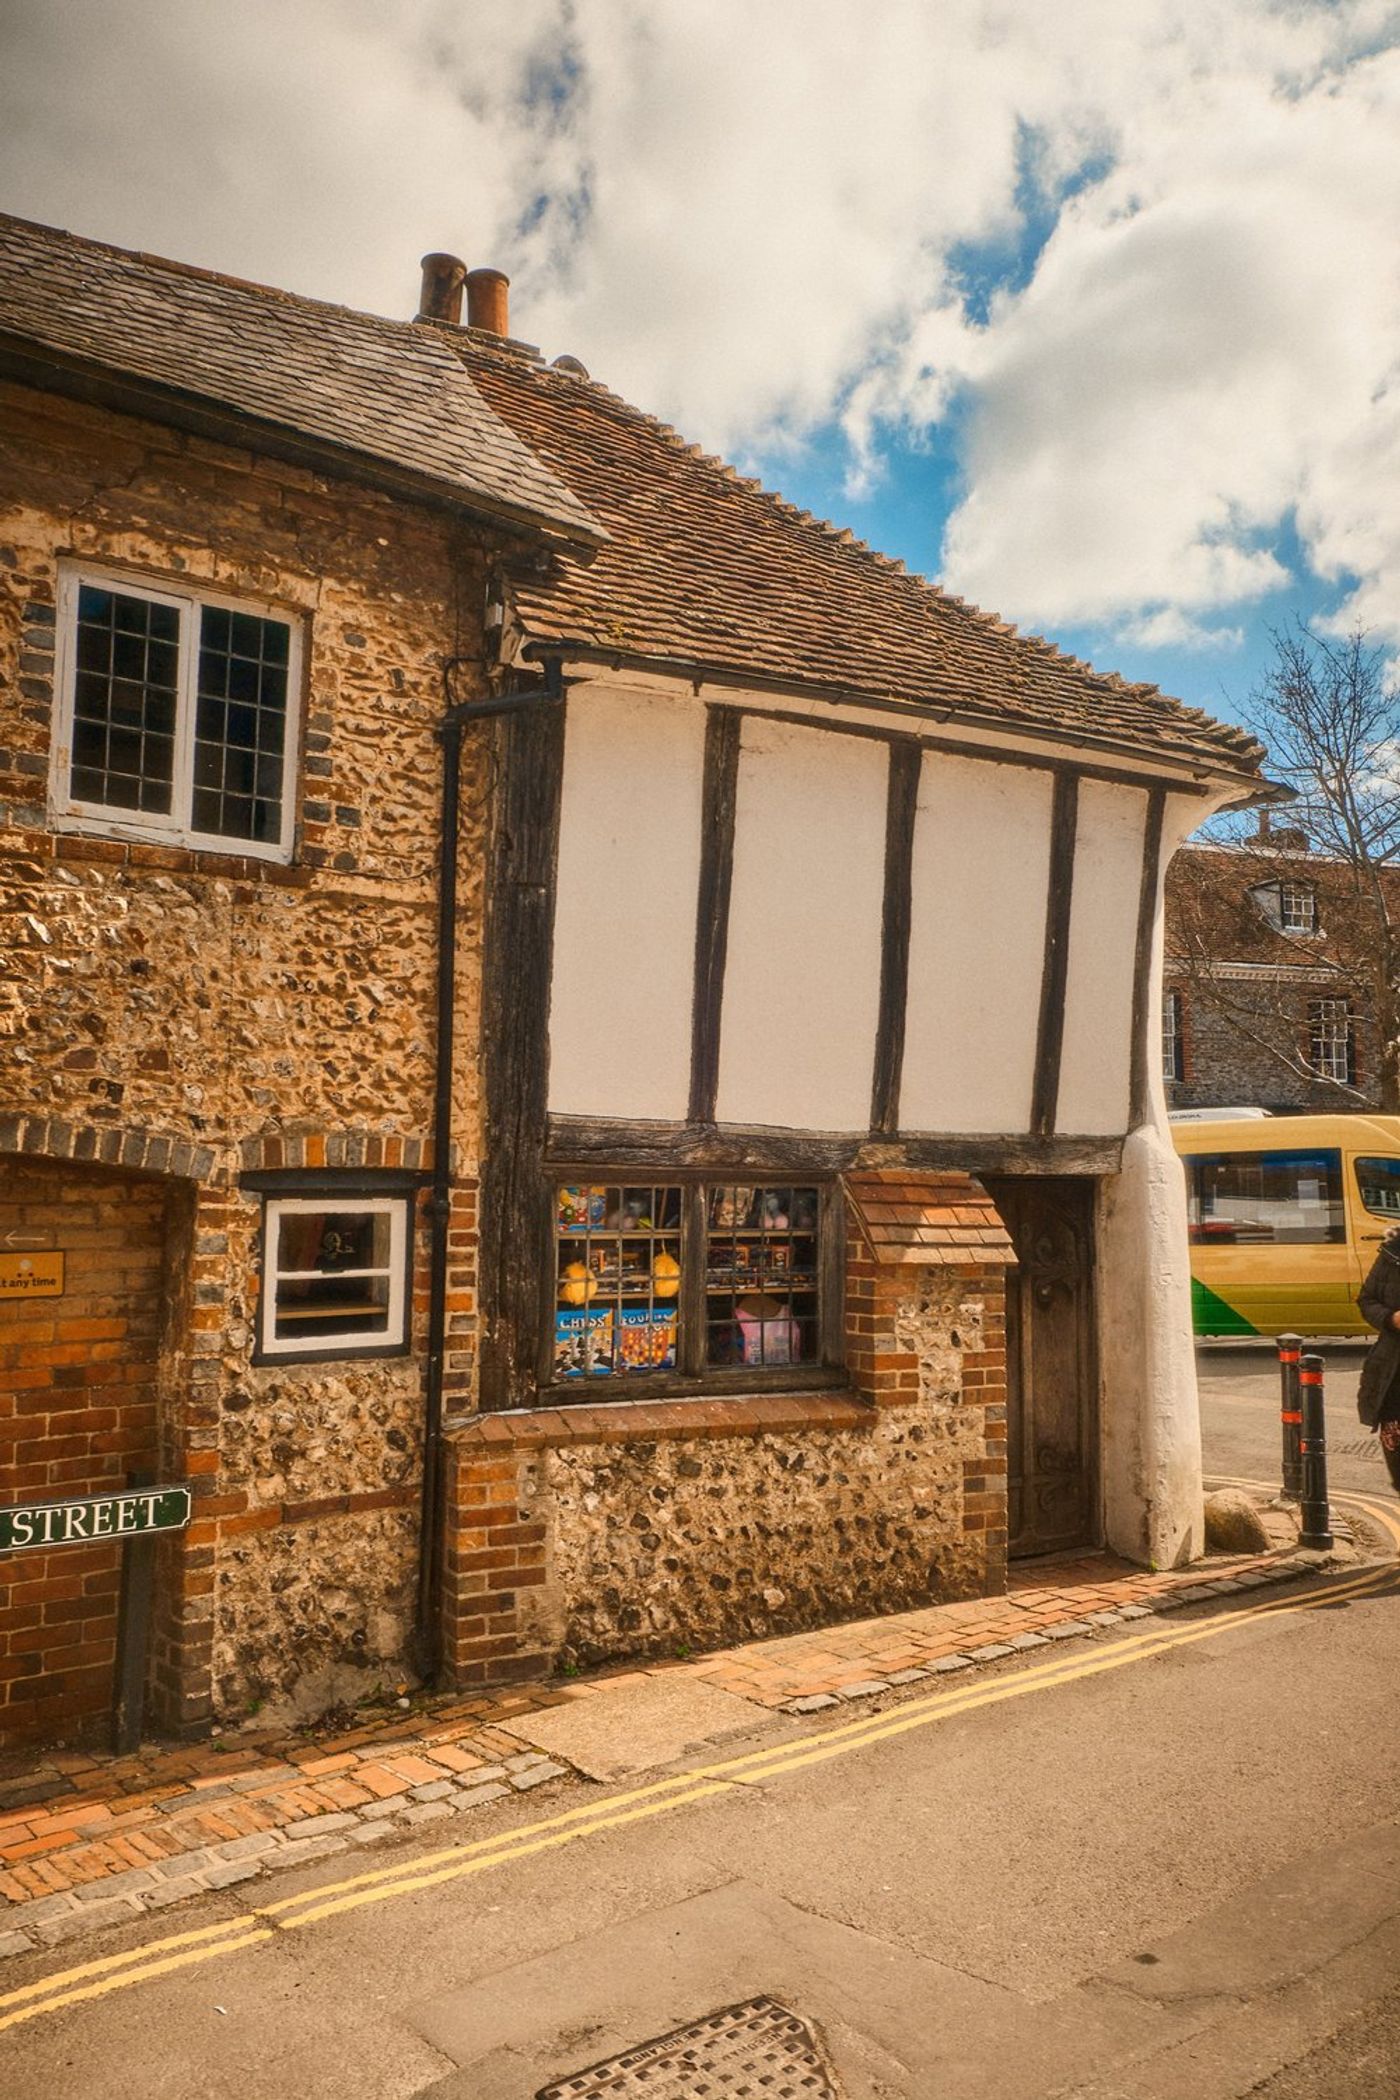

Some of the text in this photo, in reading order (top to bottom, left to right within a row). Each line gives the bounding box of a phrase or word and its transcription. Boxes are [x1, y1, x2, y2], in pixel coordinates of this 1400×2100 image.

[9, 1279, 29, 1289] any
[32, 1277, 56, 1287] time
[11, 1495, 163, 1546] STREET
[633, 2034, 690, 2063] ENGLAND
